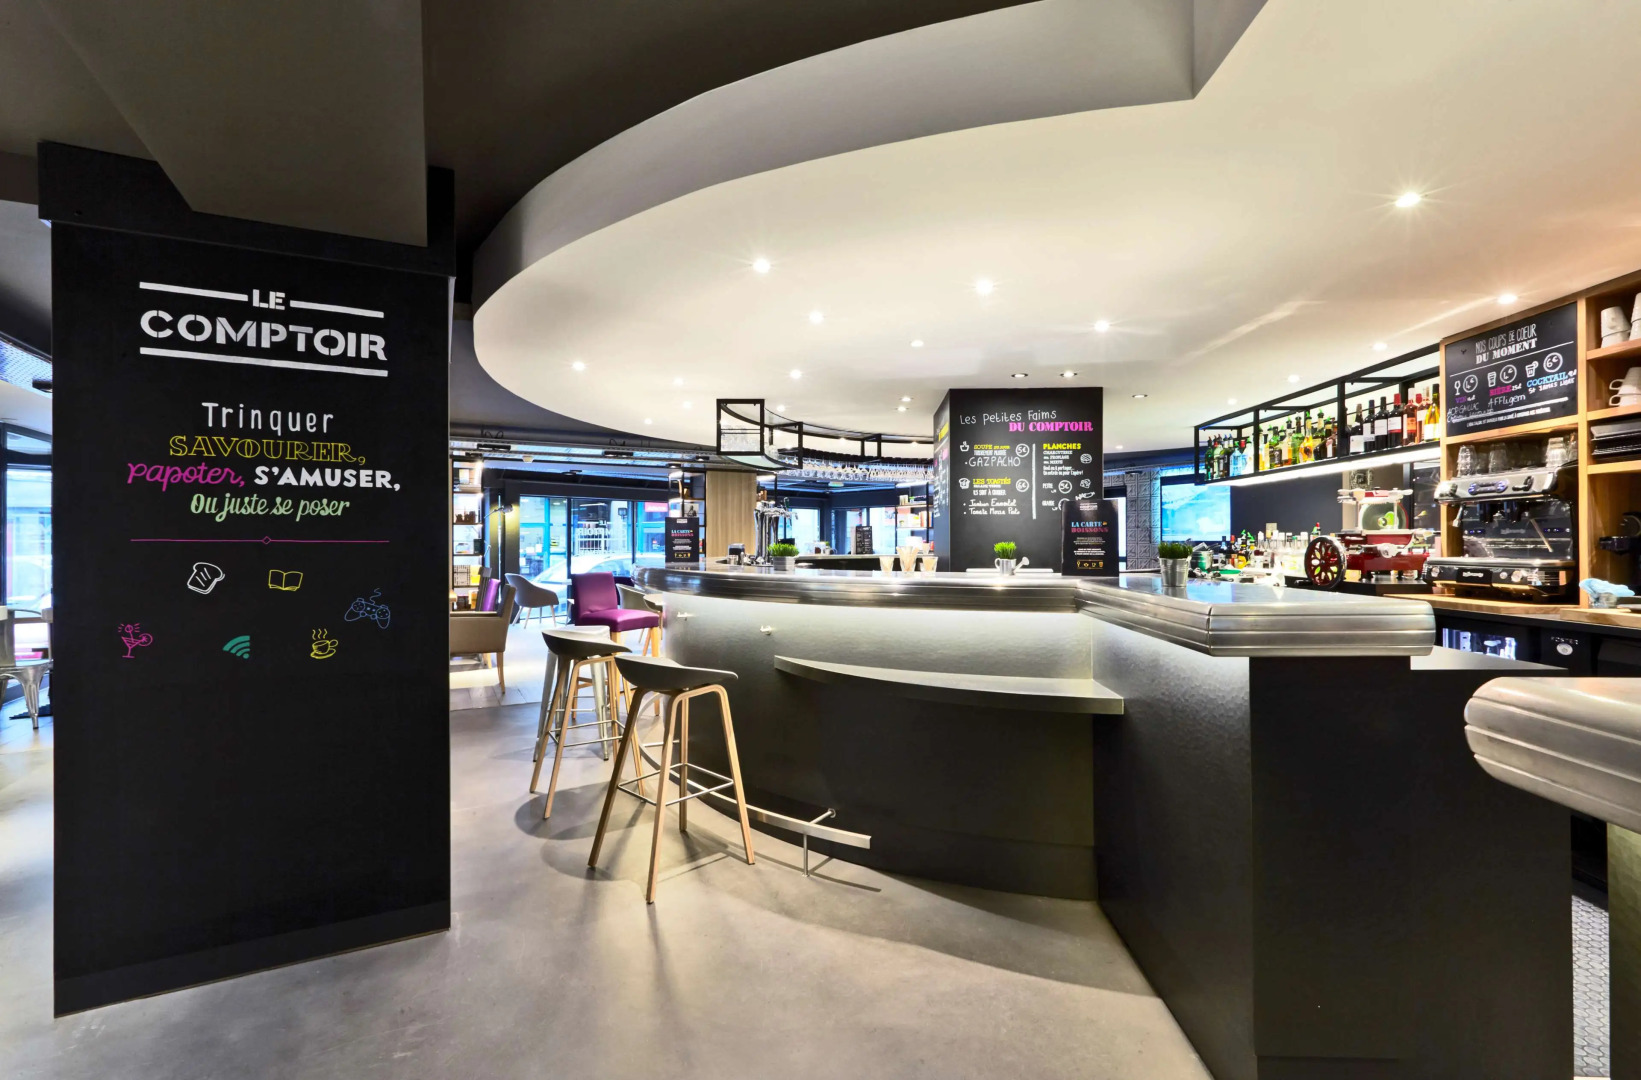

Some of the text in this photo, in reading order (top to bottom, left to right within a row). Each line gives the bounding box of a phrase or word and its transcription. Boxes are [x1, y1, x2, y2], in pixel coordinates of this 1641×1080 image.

[253, 289, 285, 310] LE
[140, 309, 388, 361] COMPTOIR
[1475, 338, 1538, 364] DU MOMENT
[1526, 371, 1568, 387] COCKTAIL
[202, 402, 334, 436] Trinquer
[960, 414, 977, 425] Les
[1008, 421, 1094, 432] DU COMPTOIR
[169, 435, 366, 466] SAVOURER,
[968, 456, 1021, 467] GAZPACHO
[215, 493, 270, 522] juste
[270, 496, 293, 516] se
[295, 498, 351, 522] poser
